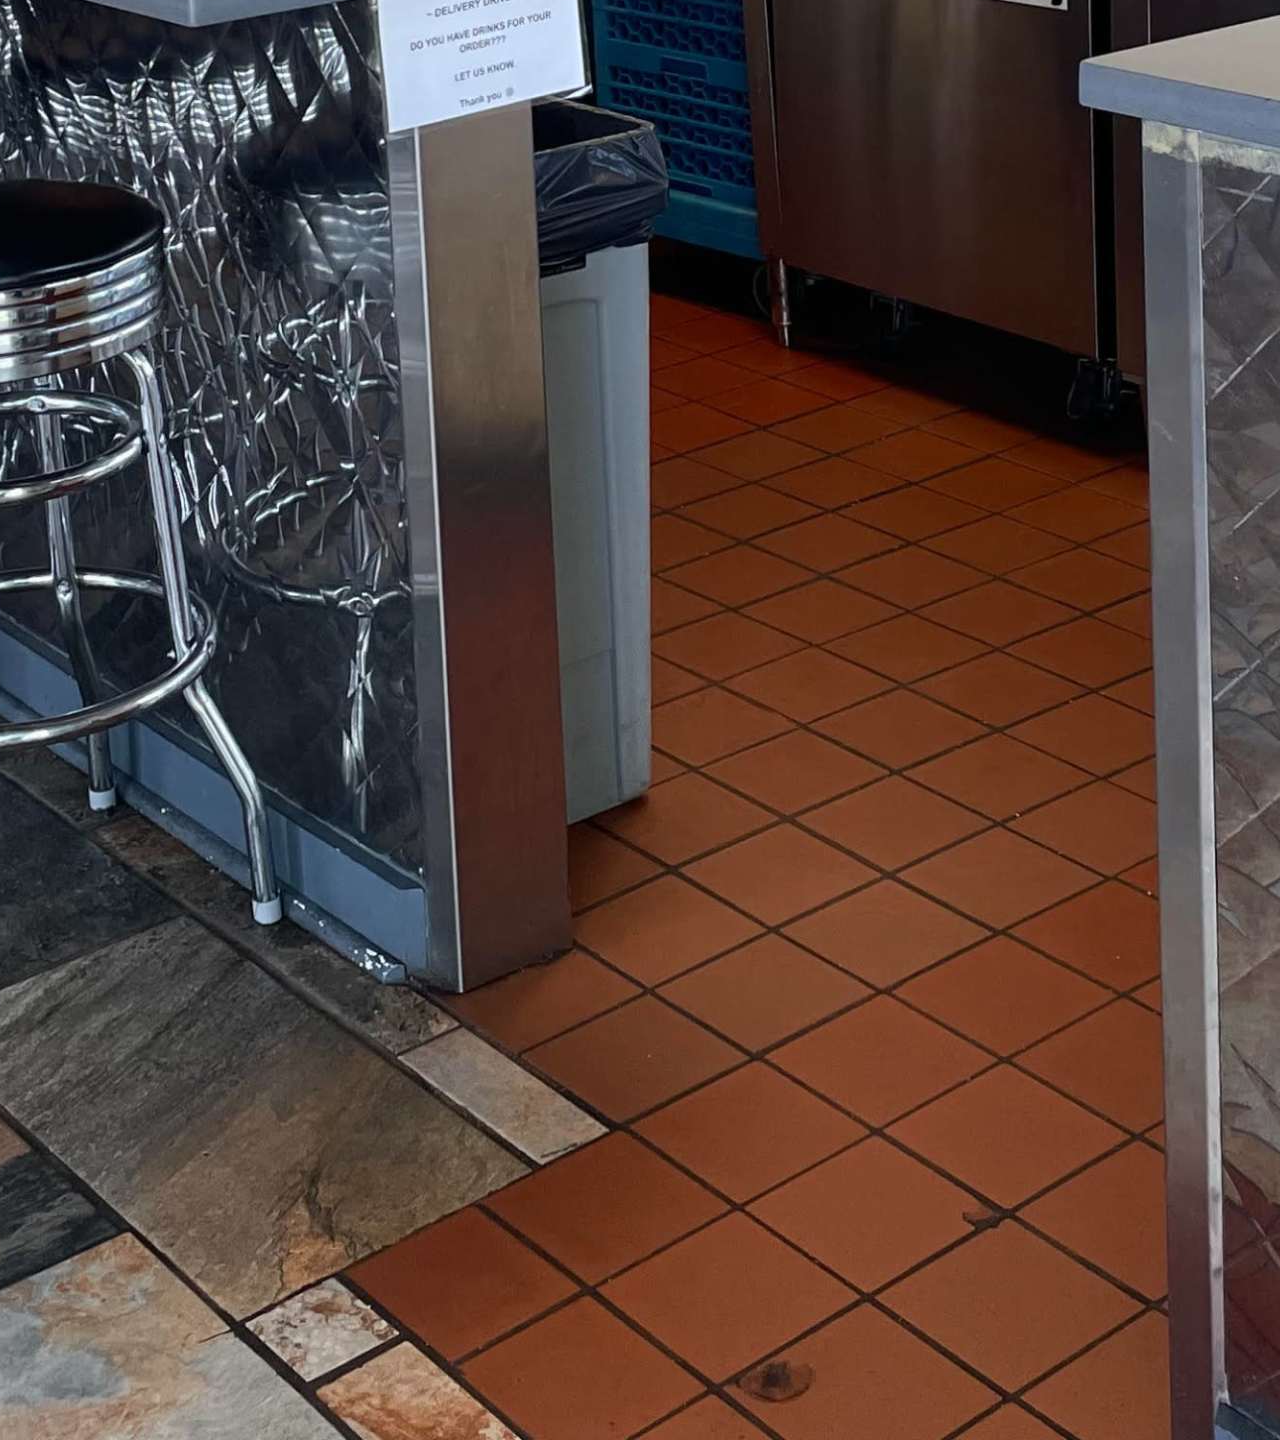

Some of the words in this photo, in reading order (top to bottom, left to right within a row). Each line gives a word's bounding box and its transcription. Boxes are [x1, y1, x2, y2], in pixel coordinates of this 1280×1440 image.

[410, 40, 424, 52] DO
[426, 35, 446, 48] YOU
[446, 29, 471, 43] HAVE
[472, 22, 506, 38] DRINKS
[507, 16, 525, 29] FOR
[527, 10, 552, 25] YOUR
[458, 35, 506, 54] ORDER???
[454, 70, 471, 83] LET
[472, 66, 486, 78] US
[487, 60, 515, 74] KNOW
[460, 94, 485, 109] Thank
[486, 91, 503, 105] you
